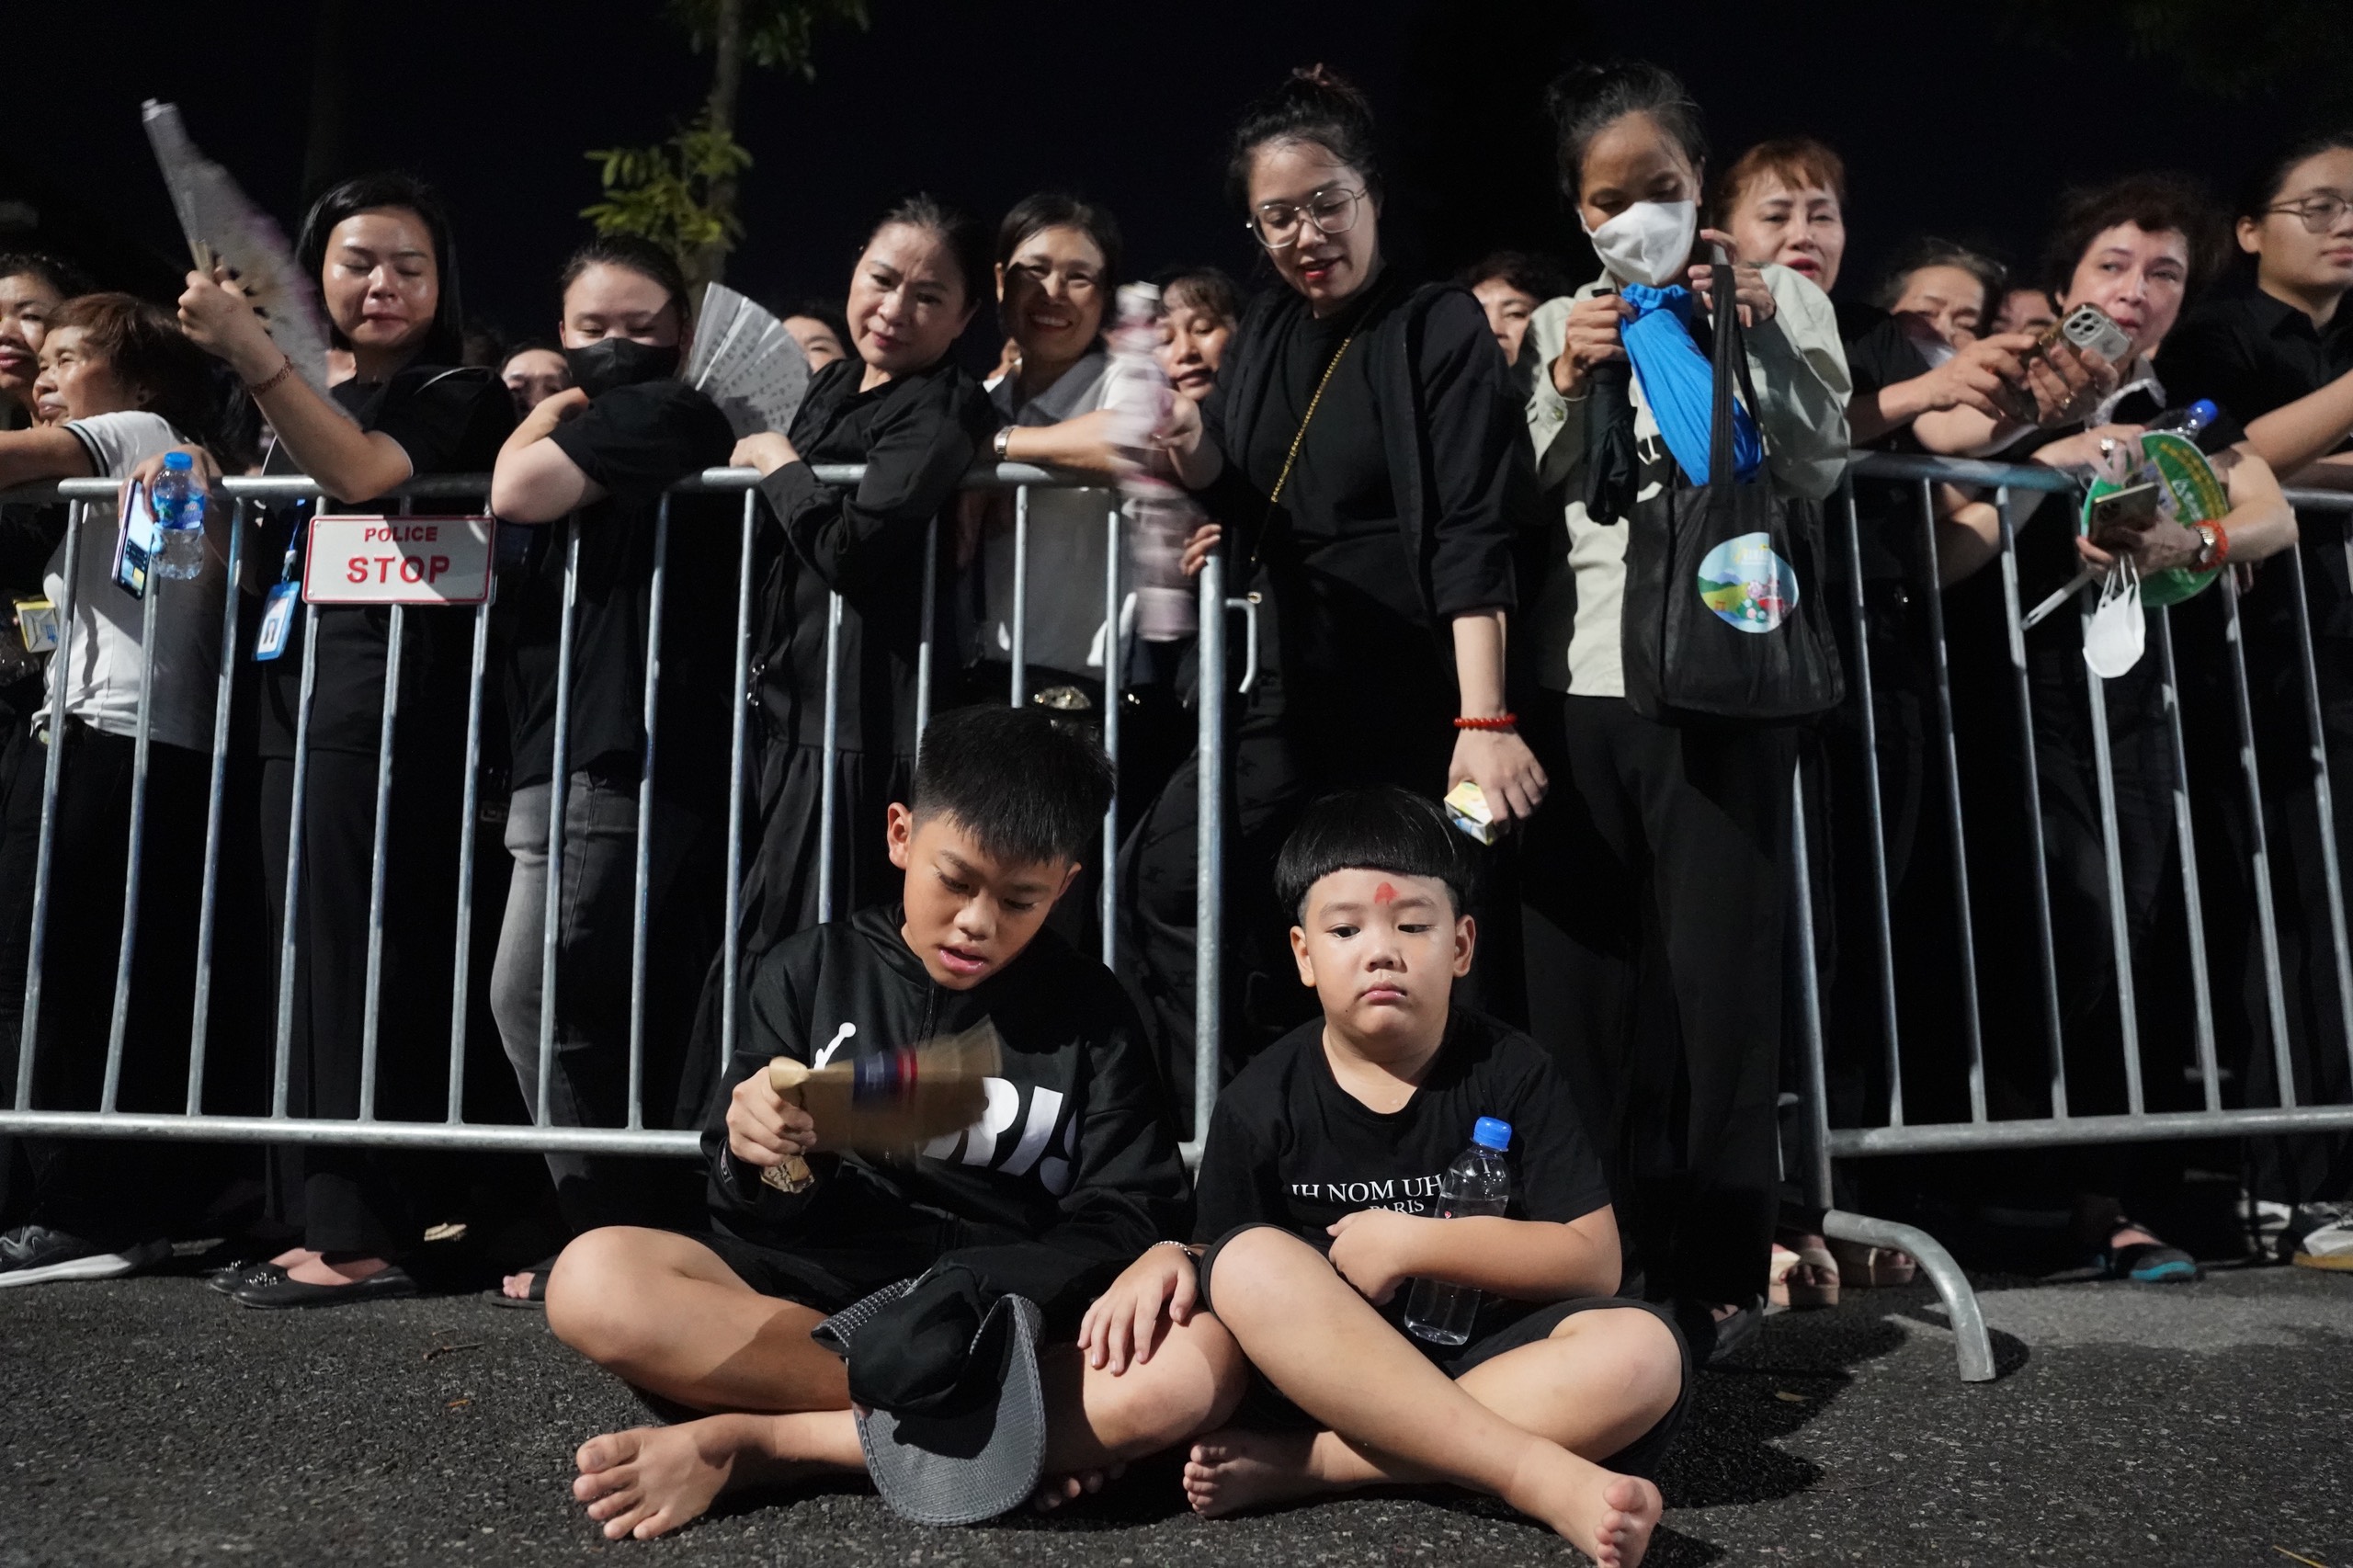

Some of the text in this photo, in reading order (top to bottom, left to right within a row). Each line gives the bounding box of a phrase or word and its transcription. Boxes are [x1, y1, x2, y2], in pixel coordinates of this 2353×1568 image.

[364, 526, 438, 542] POLICE
[347, 554, 450, 585] STOP
[1326, 1179, 1394, 1203] NOM
[1401, 1173, 1442, 1198] UH
